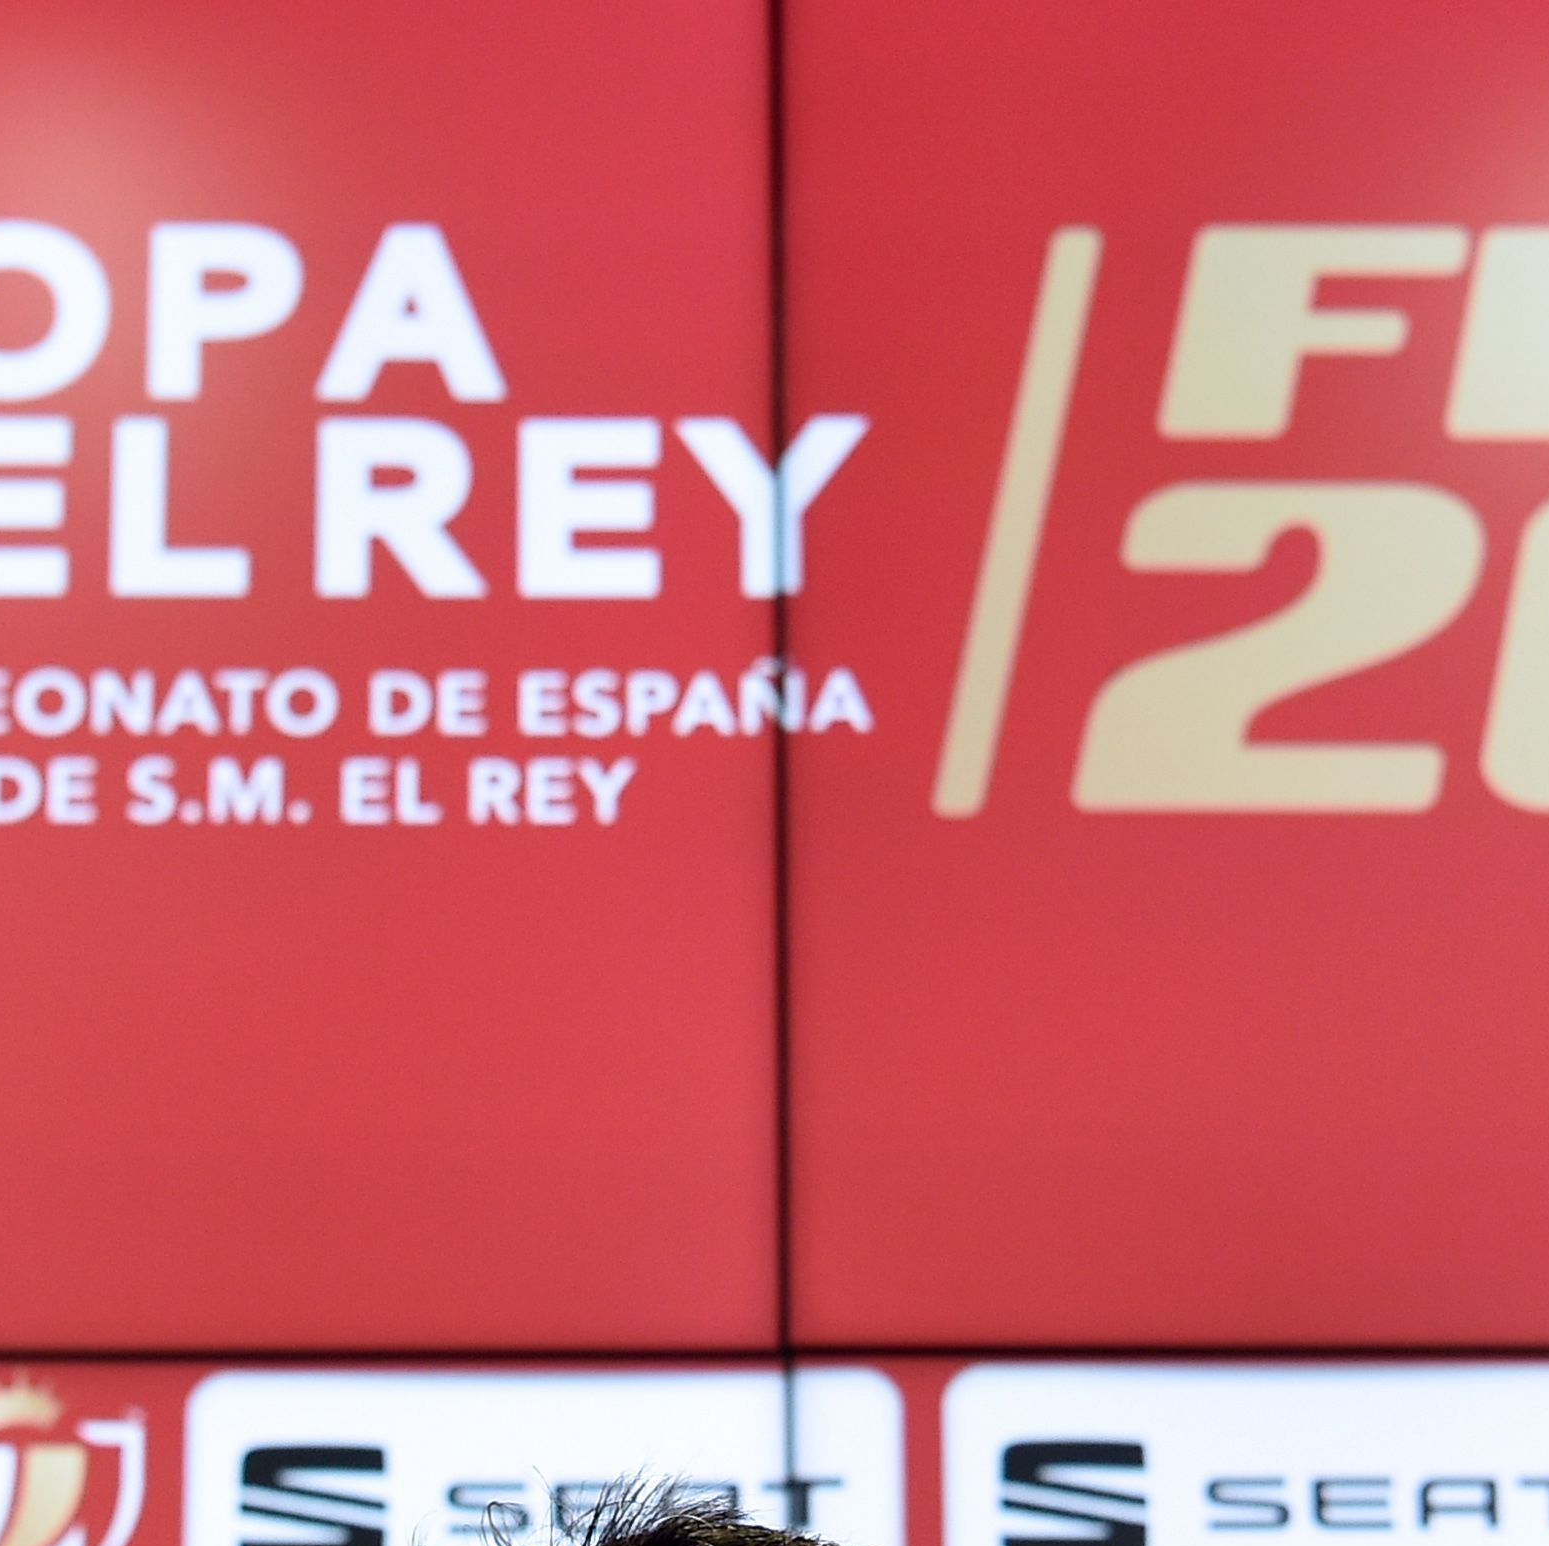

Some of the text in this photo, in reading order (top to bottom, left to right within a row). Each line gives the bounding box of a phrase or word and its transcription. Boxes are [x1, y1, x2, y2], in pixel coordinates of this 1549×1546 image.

[315, 416, 865, 599] REY
[370, 671, 485, 736] DE
[518, 660, 871, 737] ESPAÑA
[128, 757, 309, 824] S.M.
[340, 758, 440, 824] EL
[469, 758, 634, 824] REY
